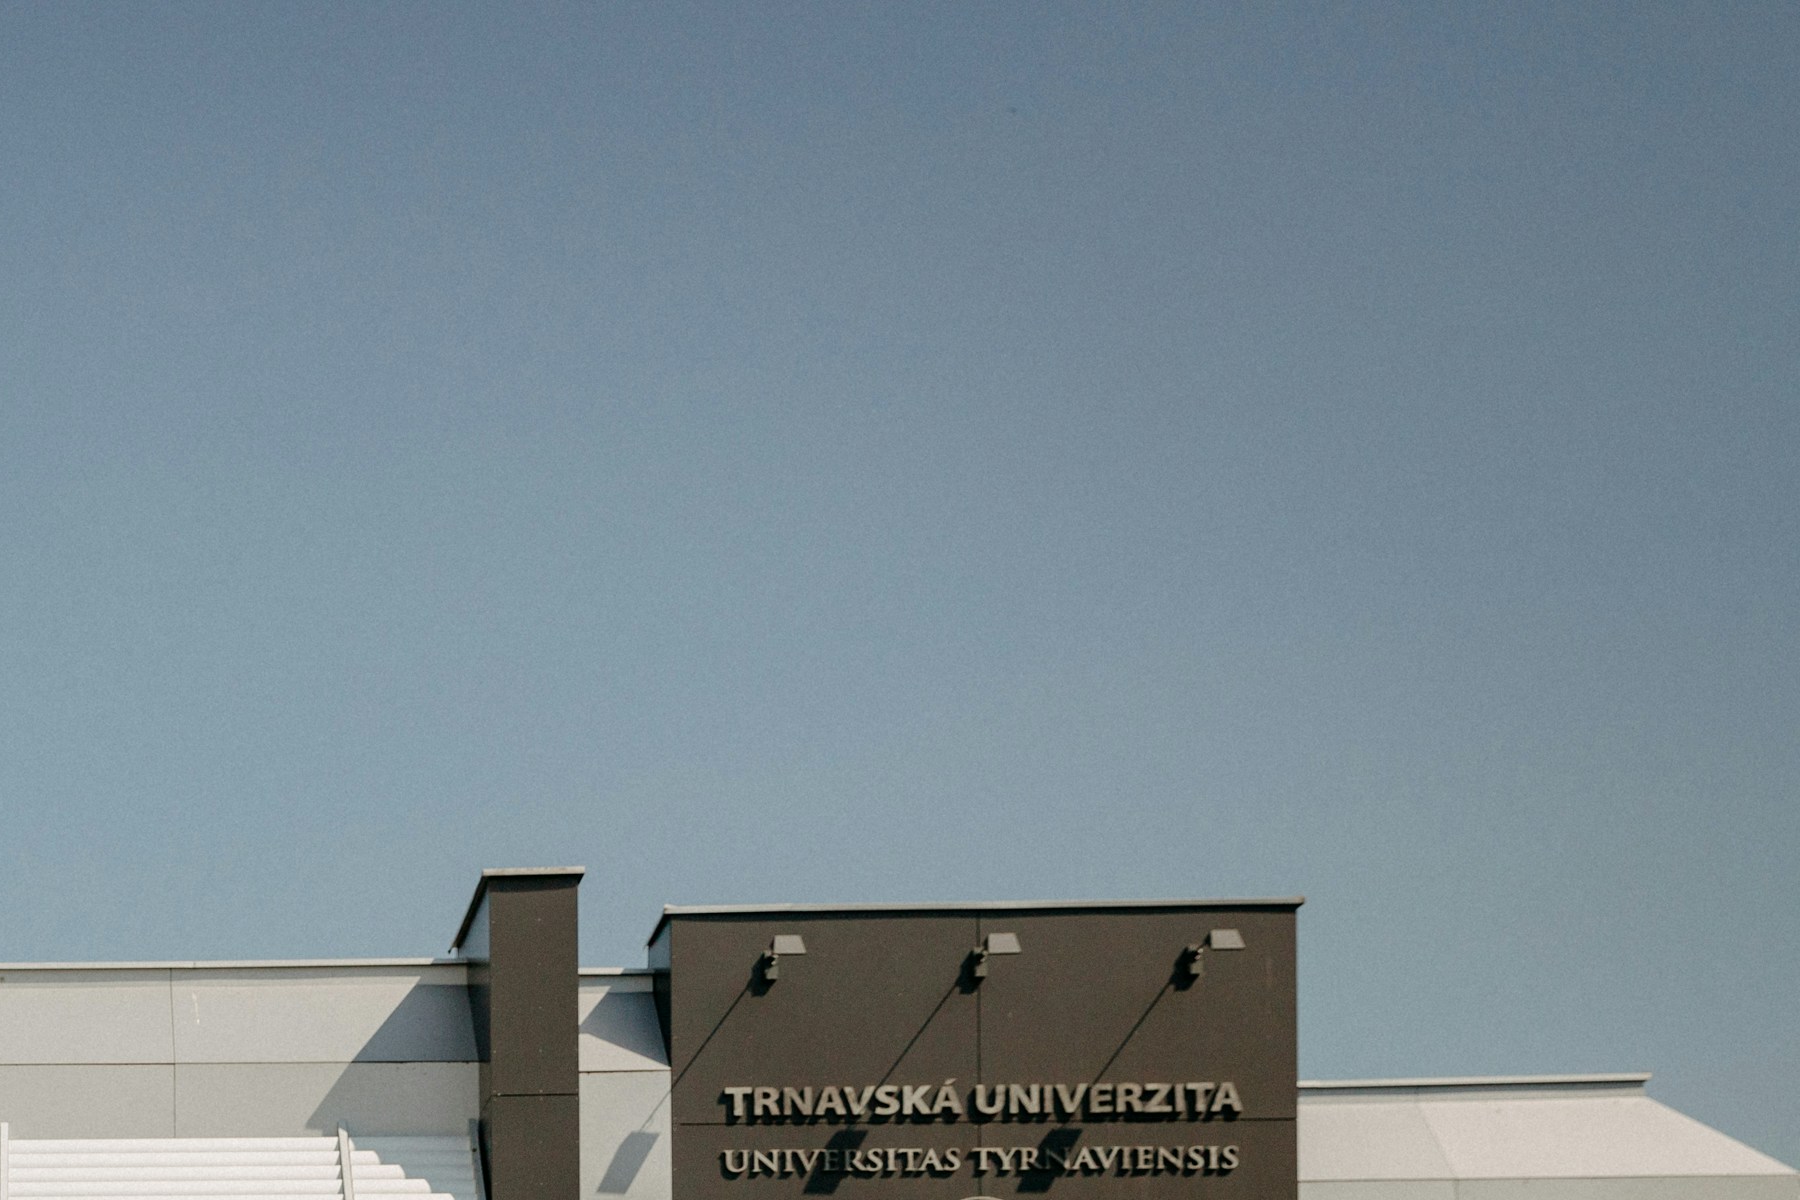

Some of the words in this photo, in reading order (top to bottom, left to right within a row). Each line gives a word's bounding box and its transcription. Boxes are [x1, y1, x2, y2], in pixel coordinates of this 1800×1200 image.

[723, 1078, 964, 1117] TRNAVSKÁ
[973, 1081, 1244, 1115] UNIVERZITA
[723, 1147, 962, 1173] UNIVERSITAS
[971, 1145, 1240, 1171] TYRNAVIENSIS
